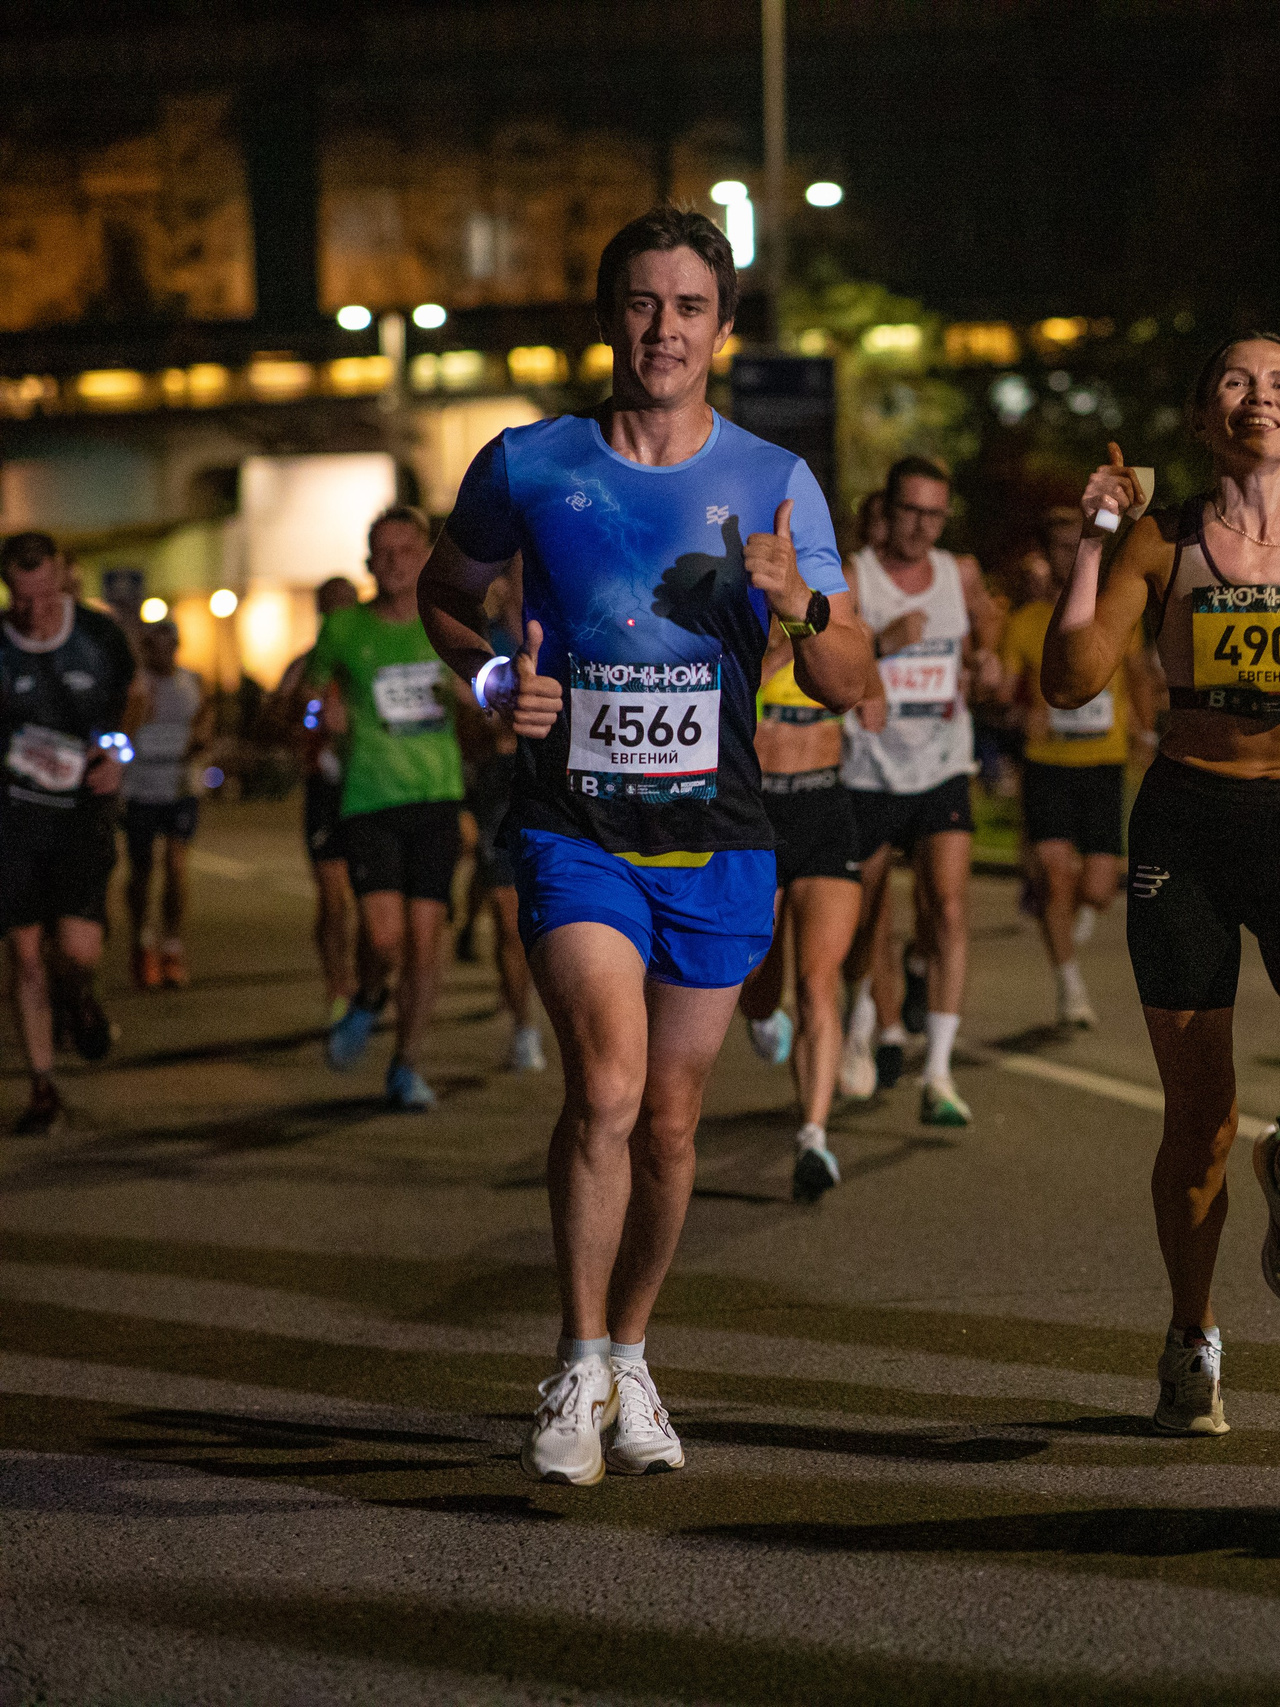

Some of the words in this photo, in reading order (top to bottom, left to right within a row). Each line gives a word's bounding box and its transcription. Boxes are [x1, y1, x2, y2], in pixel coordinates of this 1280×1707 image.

[584, 661, 712, 686] НОЧНОЙ
[589, 704, 702, 748] 4566
[611, 750, 678, 764] ЕВГЕНИЙ
